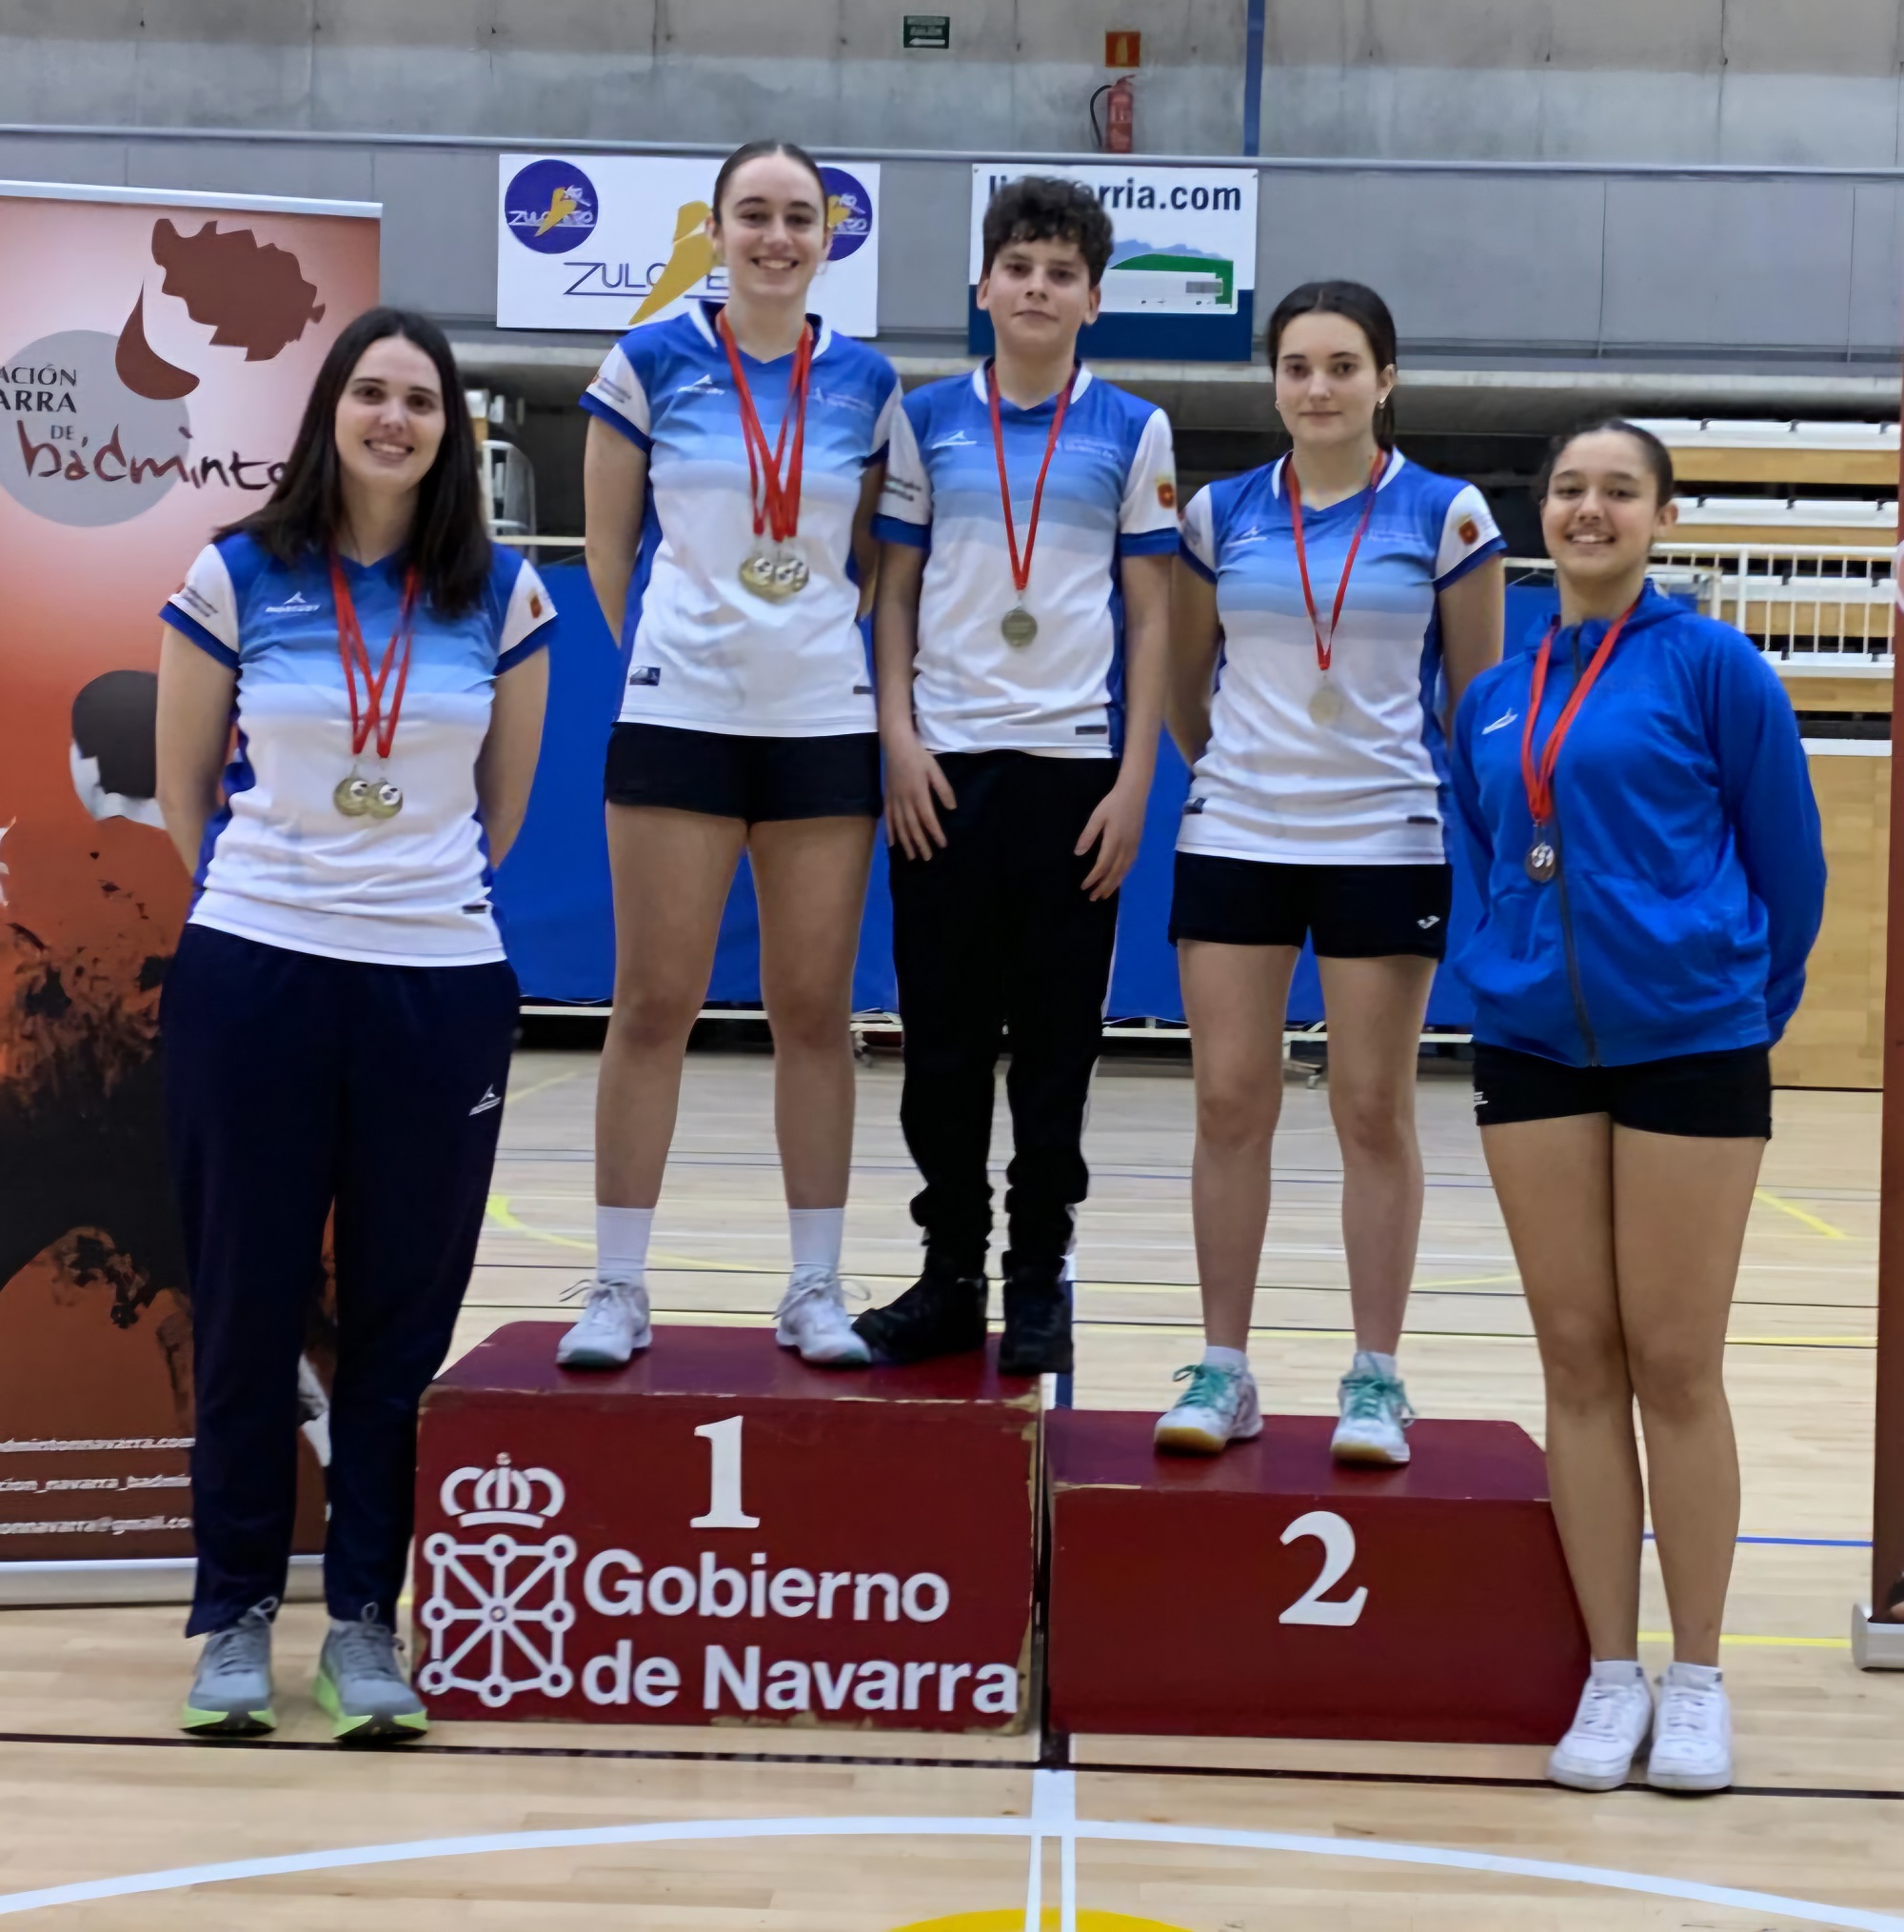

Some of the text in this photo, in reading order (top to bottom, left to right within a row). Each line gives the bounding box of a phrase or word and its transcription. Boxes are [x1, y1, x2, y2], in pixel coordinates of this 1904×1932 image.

[50, 425, 74, 440] DE
[690, 1416, 760, 1528] 1
[583, 1548, 950, 1623] Gobierno
[1279, 1510, 1368, 1626] 2
[582, 1639, 1019, 1715] de Navarra
